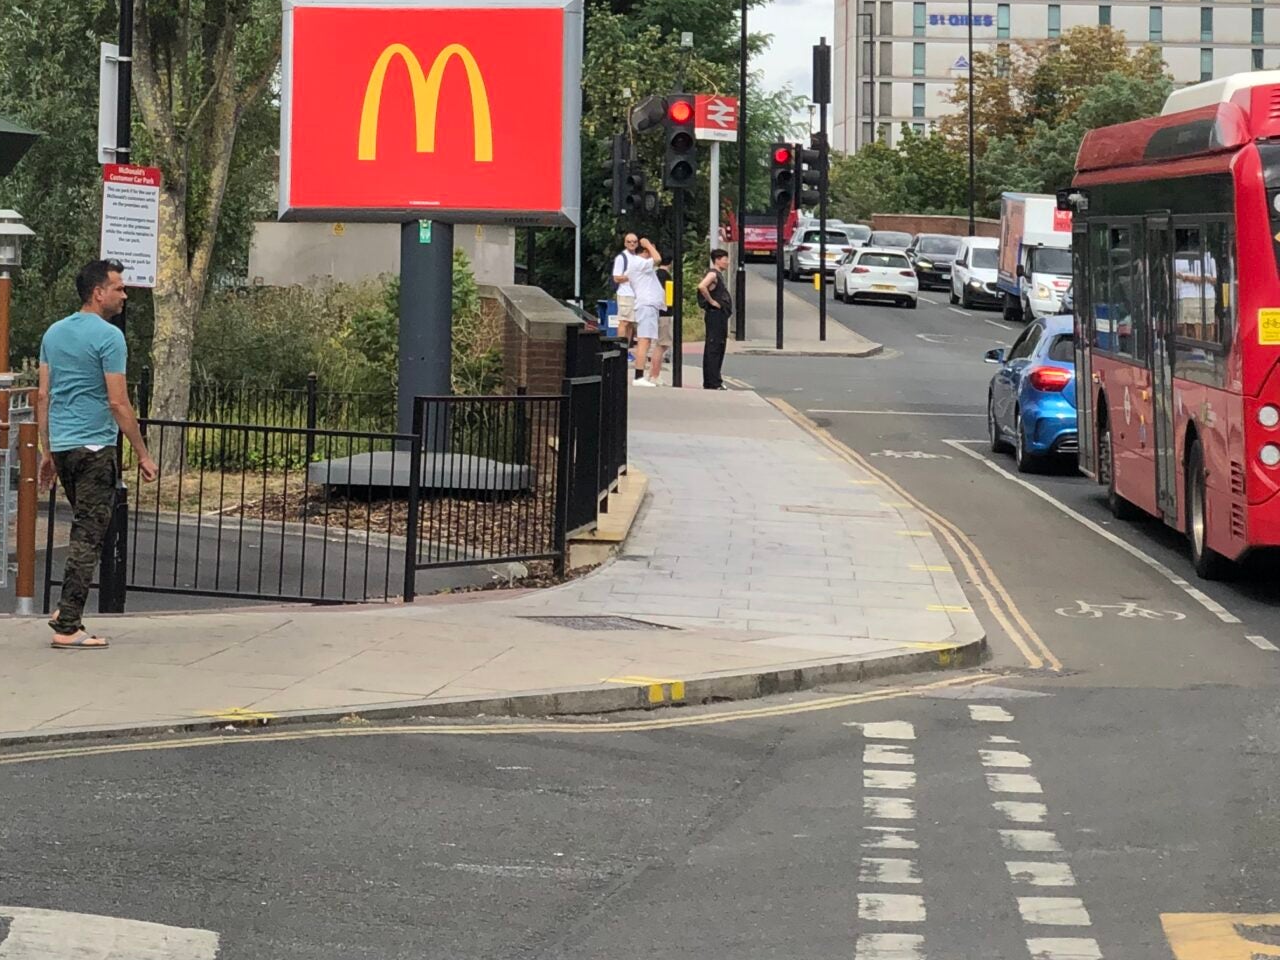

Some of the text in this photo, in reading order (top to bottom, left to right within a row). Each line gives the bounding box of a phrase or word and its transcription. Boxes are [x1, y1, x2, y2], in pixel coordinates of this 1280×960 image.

[118, 166, 146, 177] McDonald's
[109, 173, 155, 185] Customer Car Park
